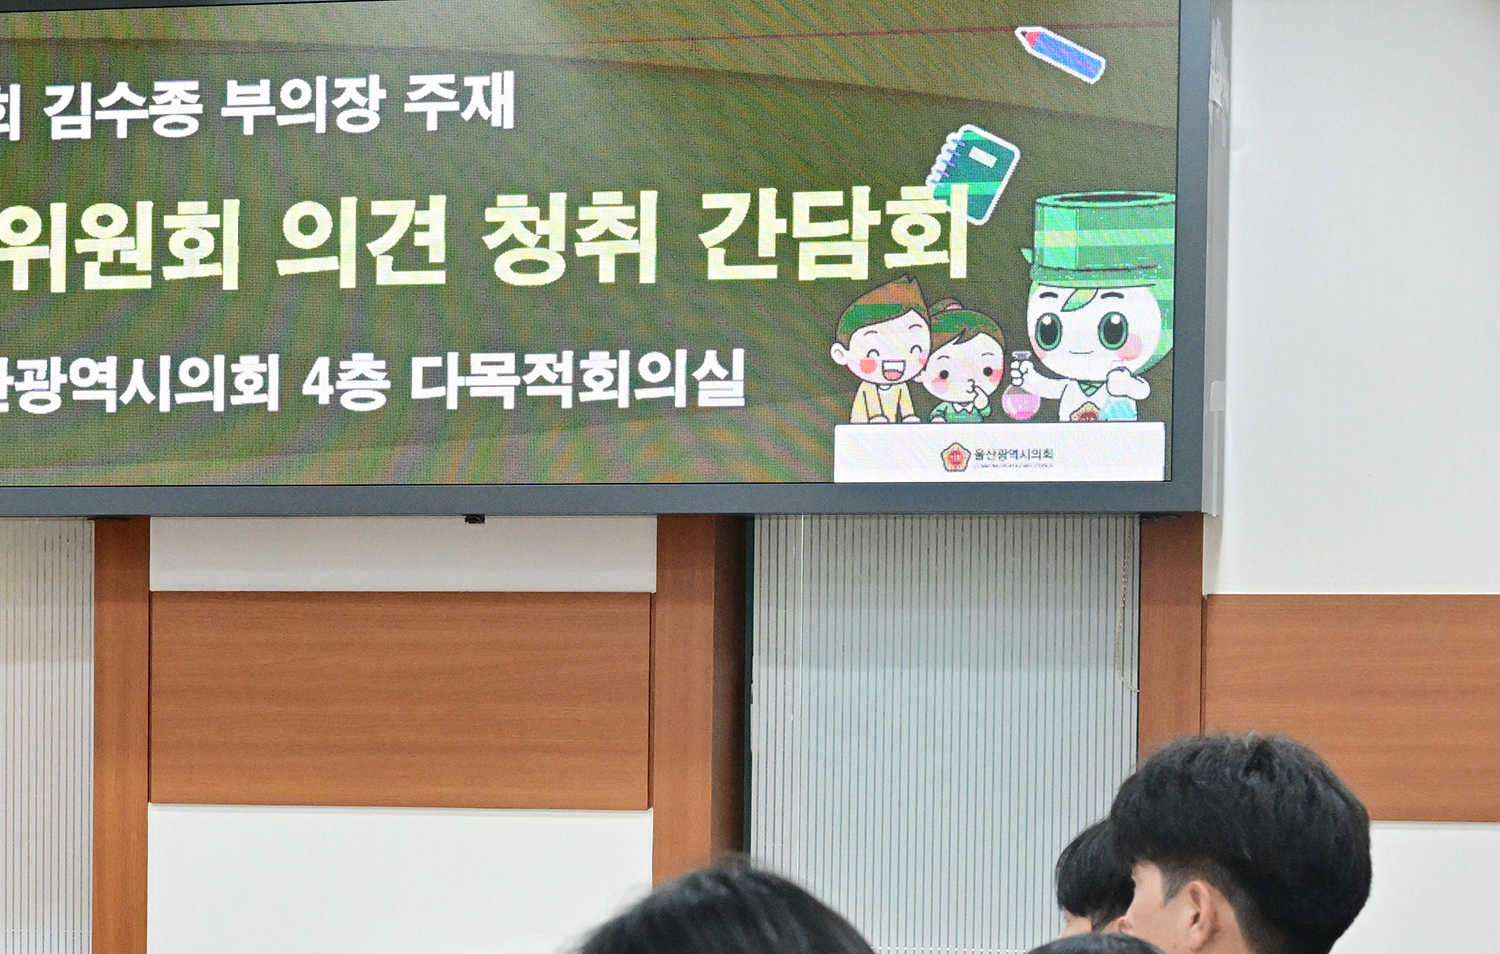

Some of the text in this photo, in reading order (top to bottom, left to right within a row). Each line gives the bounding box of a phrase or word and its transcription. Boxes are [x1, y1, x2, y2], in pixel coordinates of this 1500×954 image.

[43, 80, 203, 140] 김수종
[220, 74, 387, 136] 부의장
[404, 70, 515, 132] 주재
[275, 194, 447, 289] 의견
[481, 189, 658, 286] 청취
[698, 184, 970, 281] 간담회
[302, 352, 392, 412] 4층
[411, 348, 746, 410] 다목적회의실
